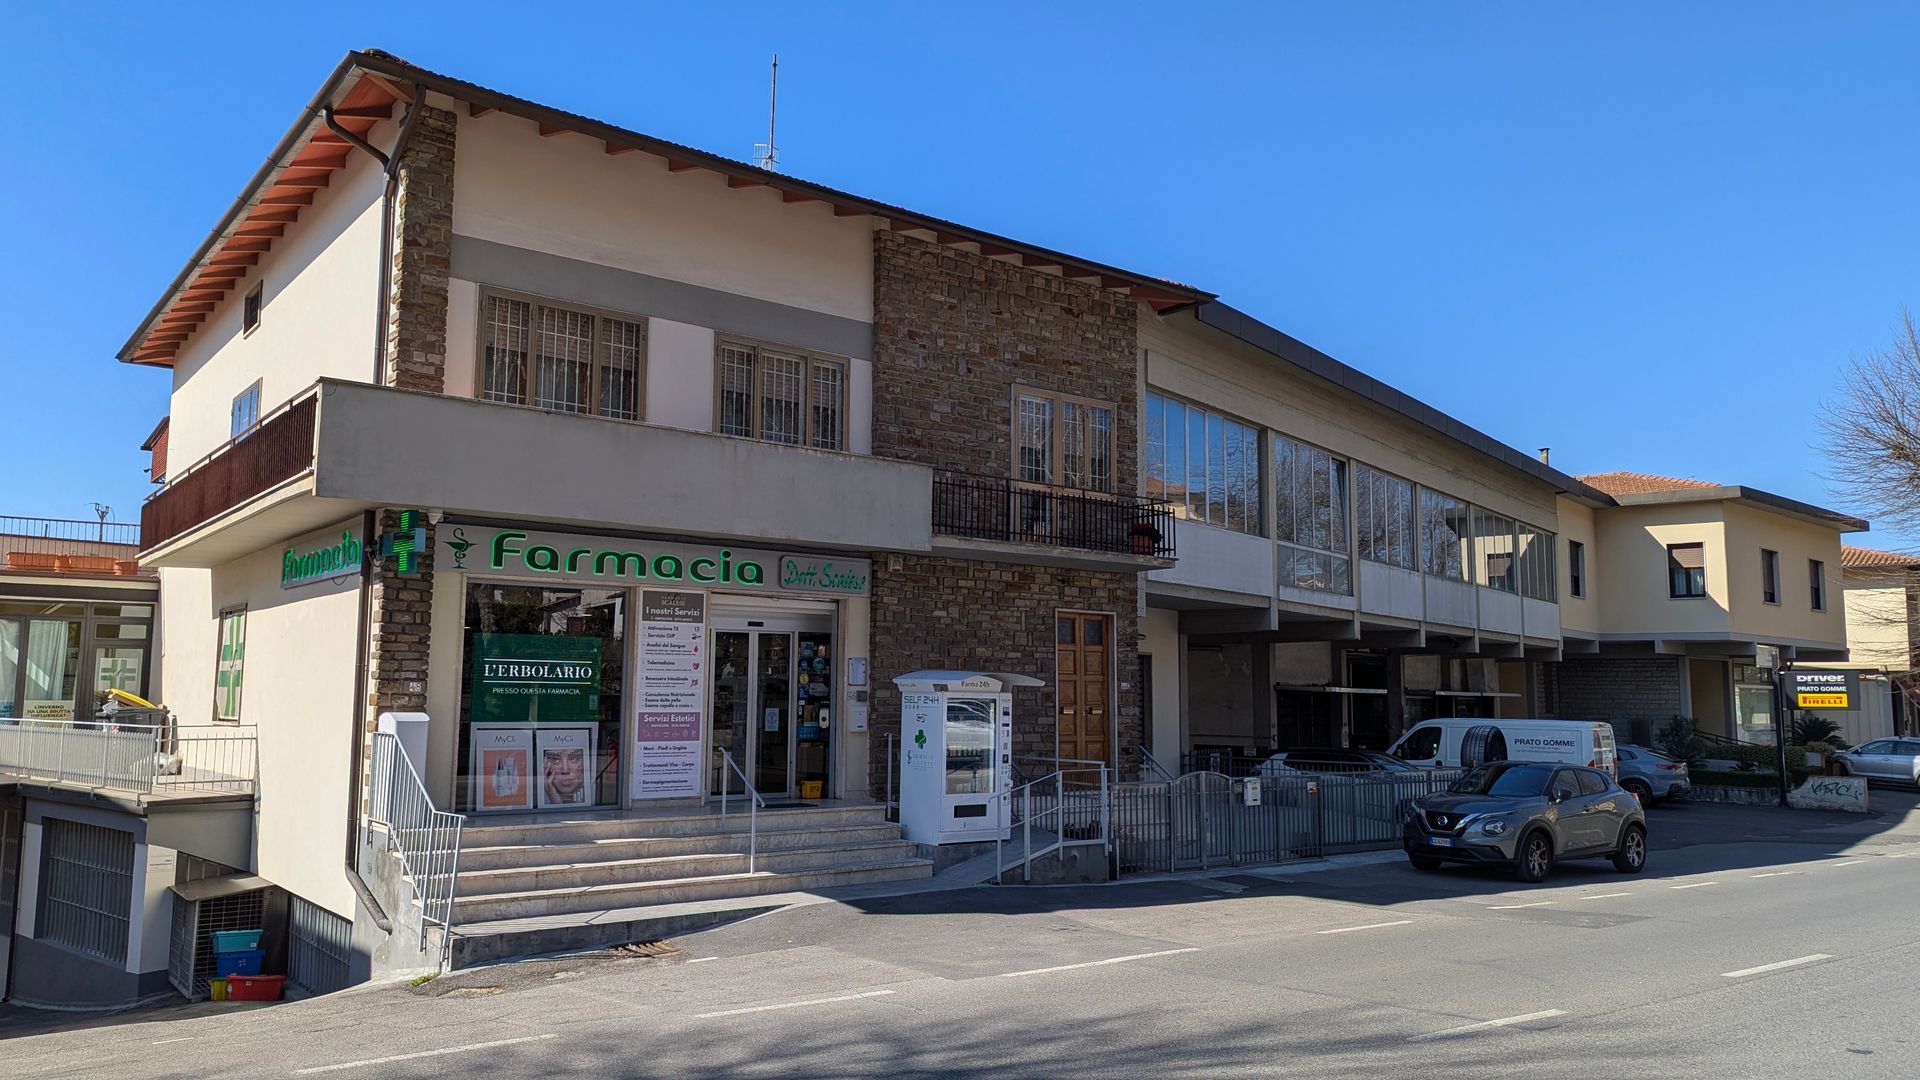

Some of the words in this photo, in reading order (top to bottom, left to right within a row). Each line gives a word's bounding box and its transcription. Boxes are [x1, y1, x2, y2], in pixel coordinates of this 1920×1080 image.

[283, 530, 361, 583] Farmacia
[490, 531, 764, 585] Farmacia
[646, 606, 649, 614] I
[651, 607, 673, 615] nostri
[674, 608, 700, 616] Servizi
[484, 664, 592, 679] L'ERBOLARIO
[904, 696, 921, 704] SELF
[923, 696, 939, 704] 24H
[1802, 696, 1843, 704] PIRELLI
